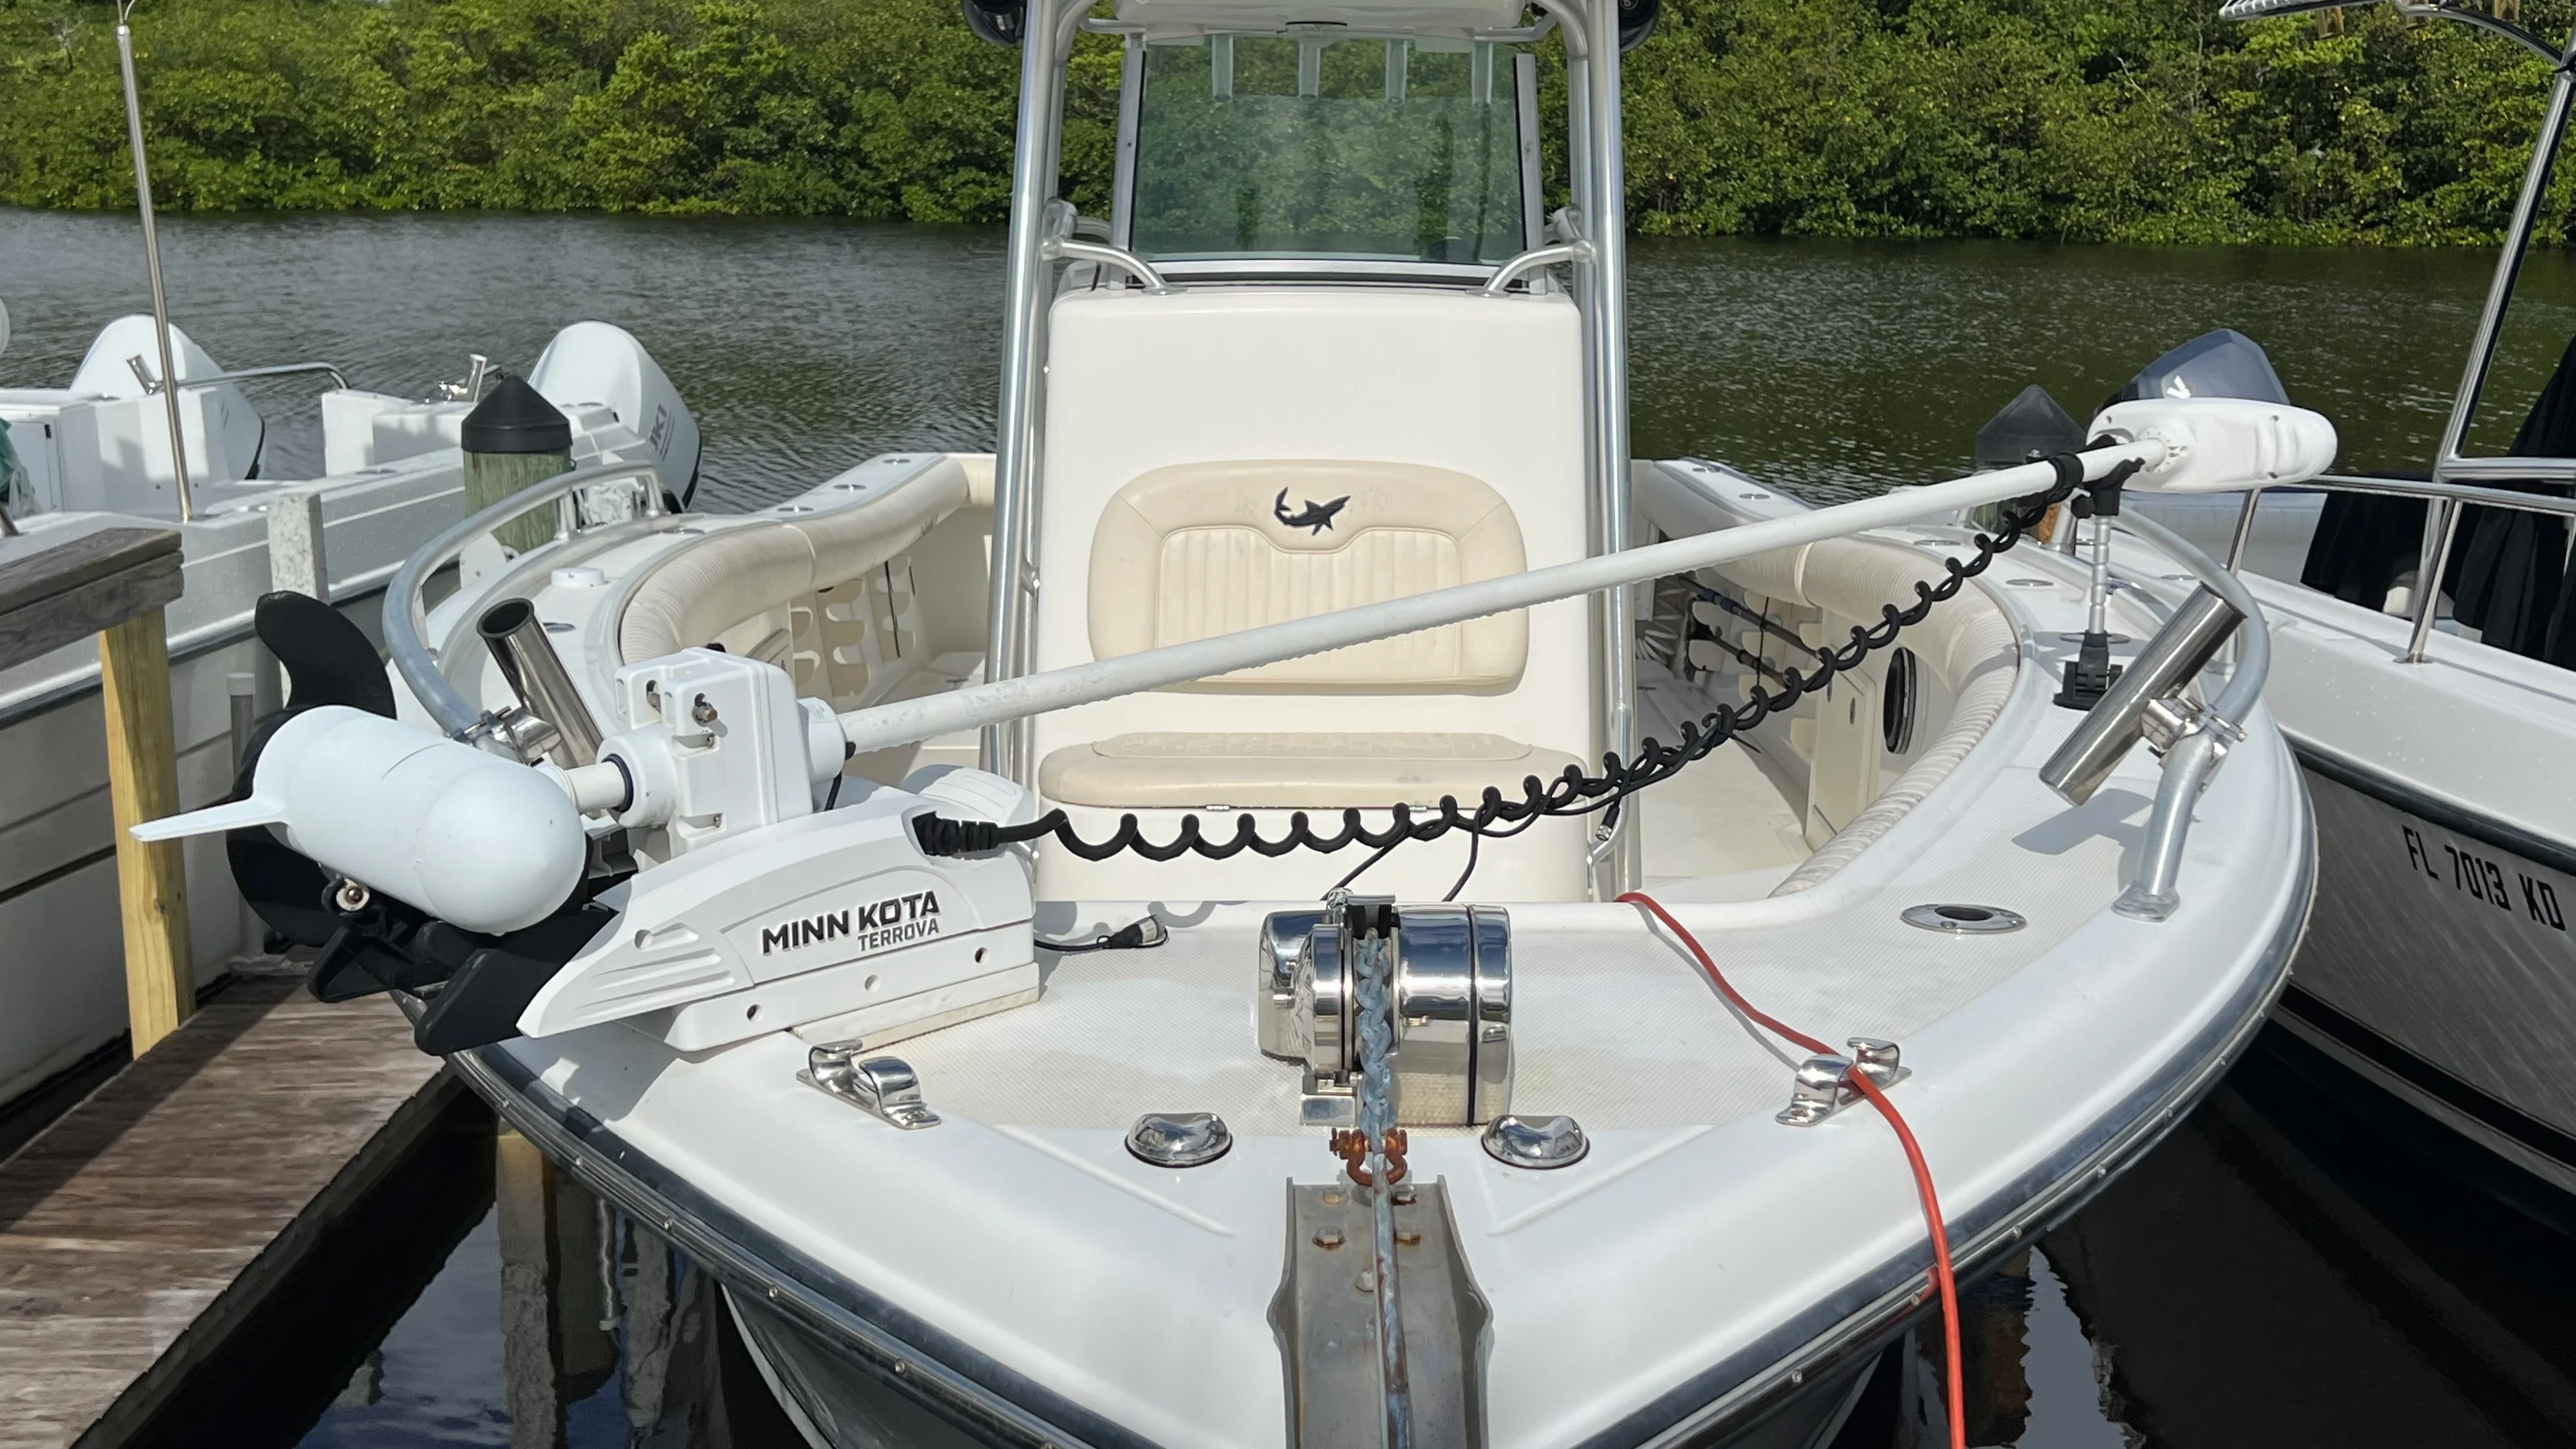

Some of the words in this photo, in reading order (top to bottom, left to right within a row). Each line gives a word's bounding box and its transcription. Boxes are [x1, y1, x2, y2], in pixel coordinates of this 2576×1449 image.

[2402, 824, 2439, 881] FL
[2444, 843, 2511, 912] 7013
[2518, 873, 2566, 931] KD
[762, 909, 850, 955] MINN
[858, 889, 940, 931] KOTA
[857, 917, 940, 951] TERROVA
